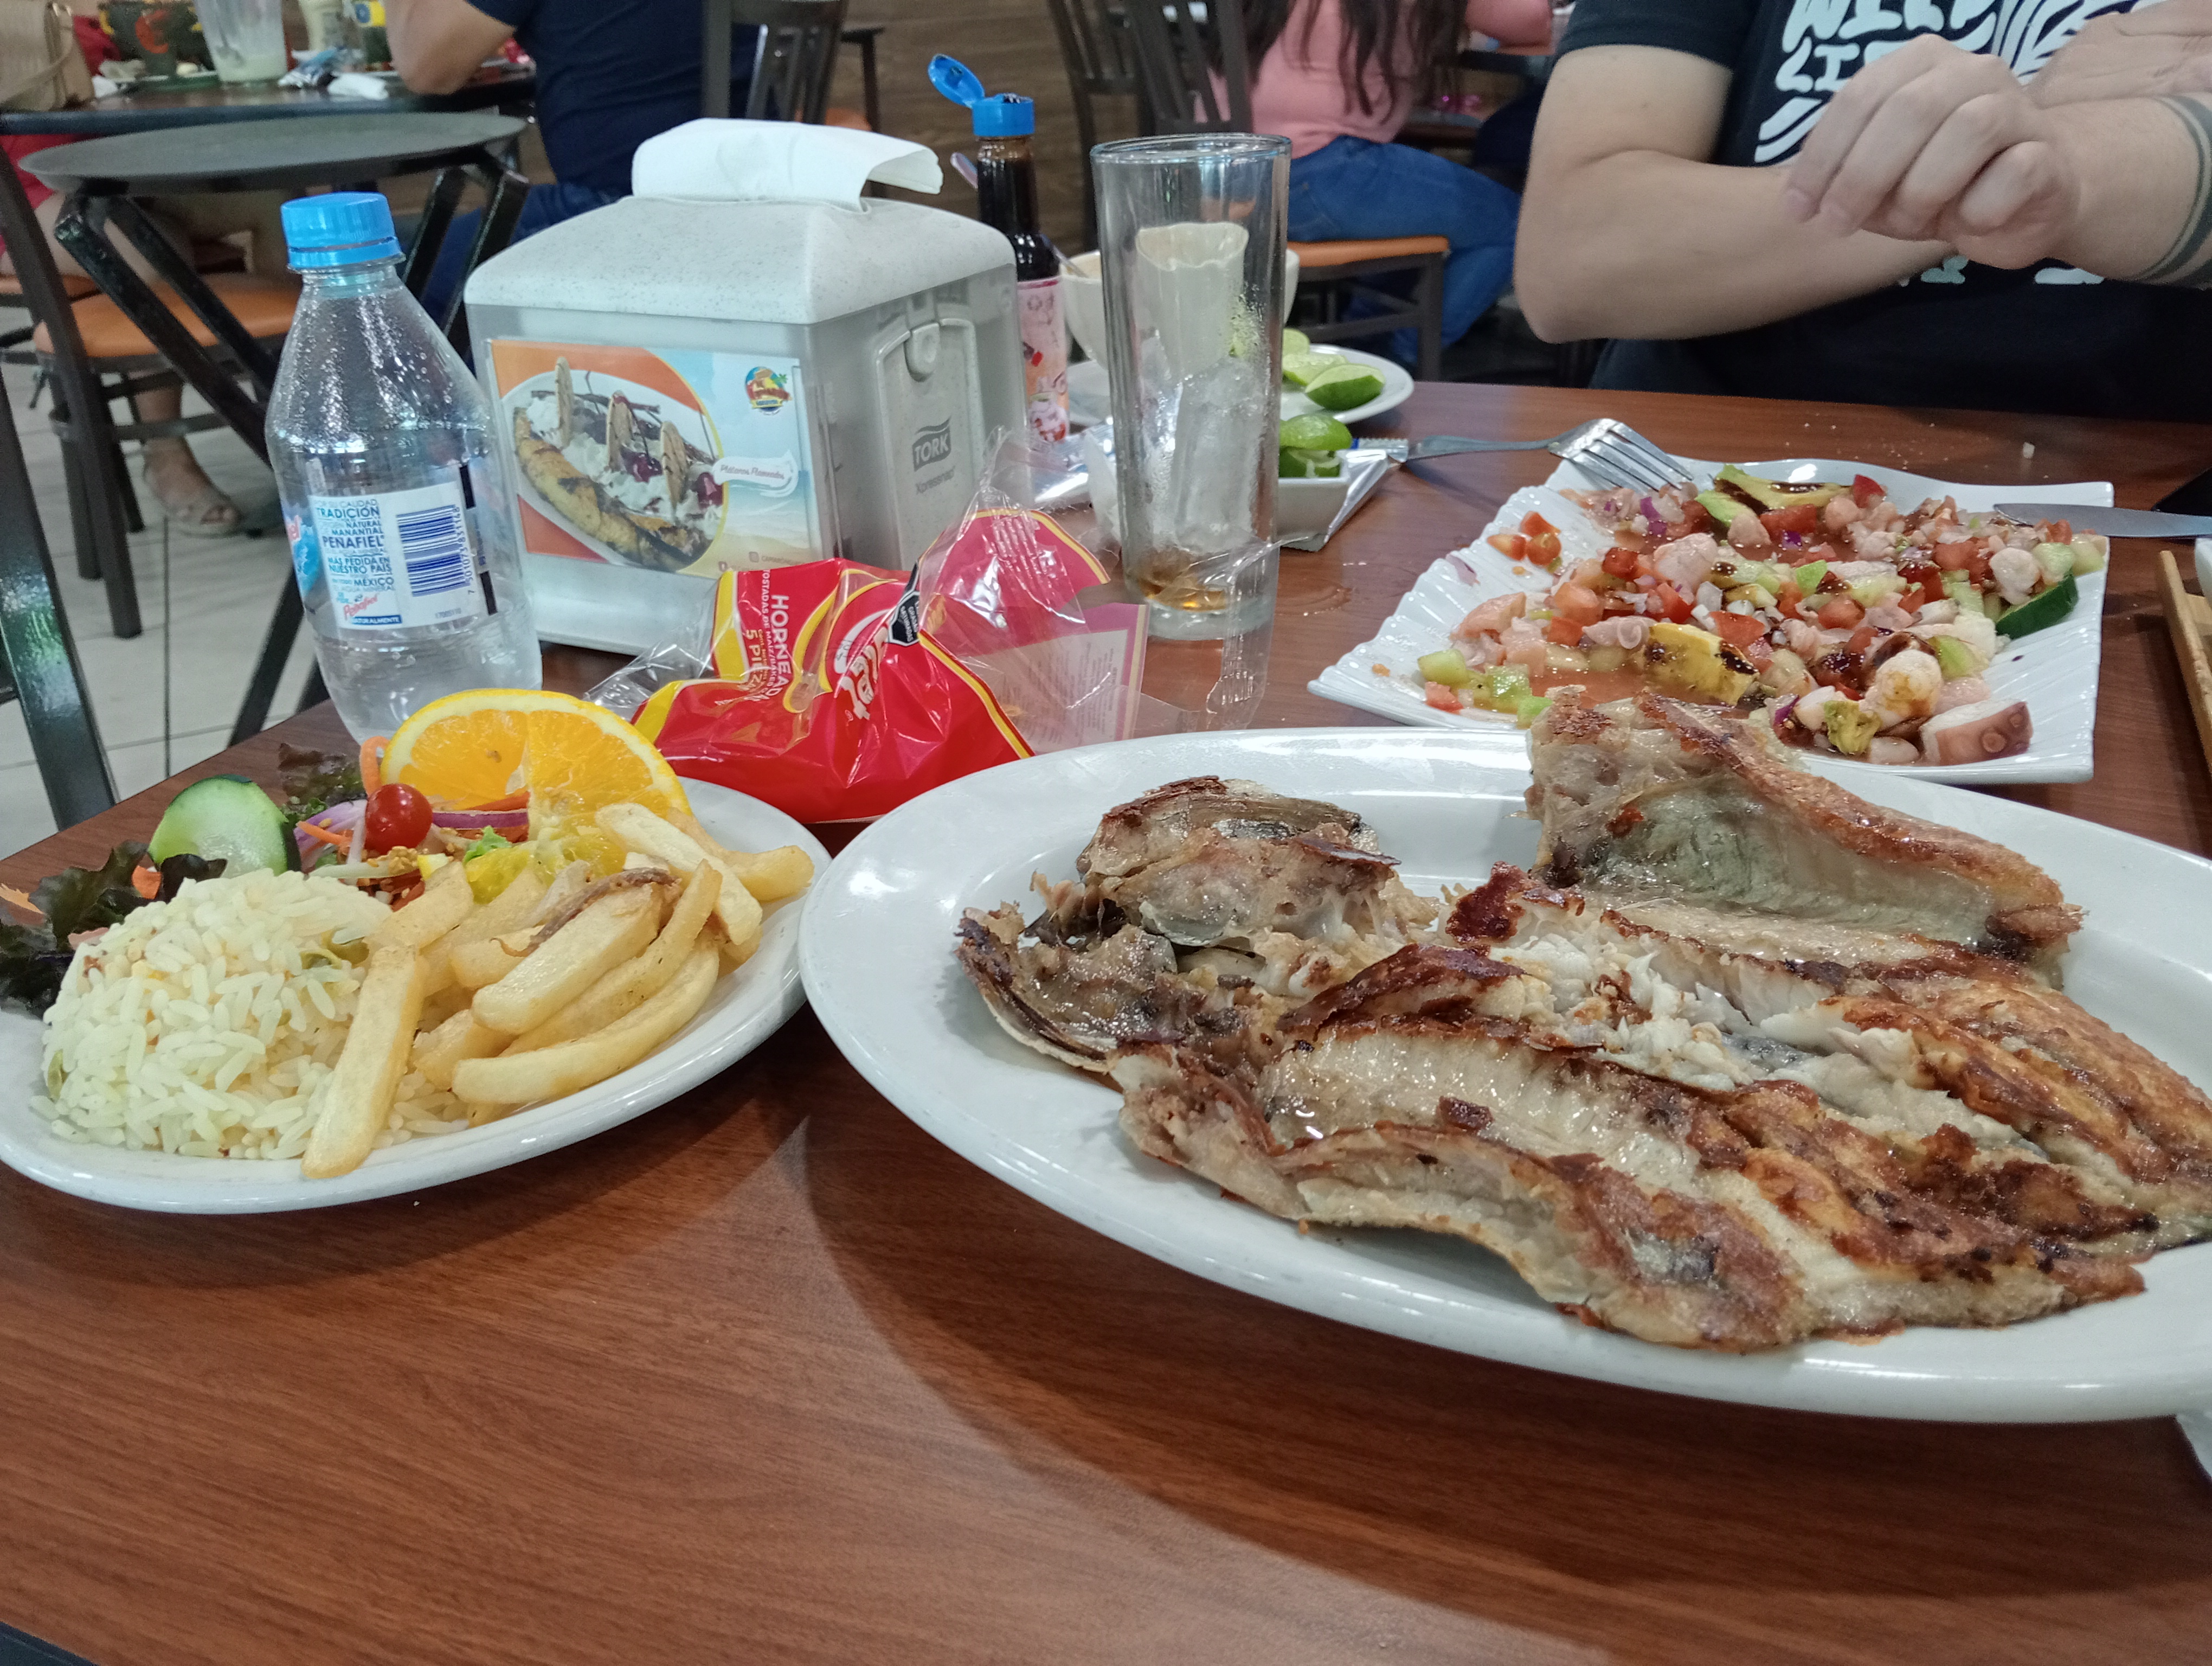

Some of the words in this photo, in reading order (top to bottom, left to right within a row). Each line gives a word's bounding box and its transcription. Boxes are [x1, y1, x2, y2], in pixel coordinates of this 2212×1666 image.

[915, 433, 949, 466] TORK
[316, 506, 380, 518] TRADICIÓN
[345, 520, 382, 528] NATURAL
[331, 528, 384, 536] MANANTIAL
[345, 557, 377, 566] PEDIDA
[329, 563, 368, 574] NUESTRO
[761, 569, 770, 613] TOSTADAS
[900, 606, 914, 642] SATURADAS
[746, 629, 758, 640] 5
